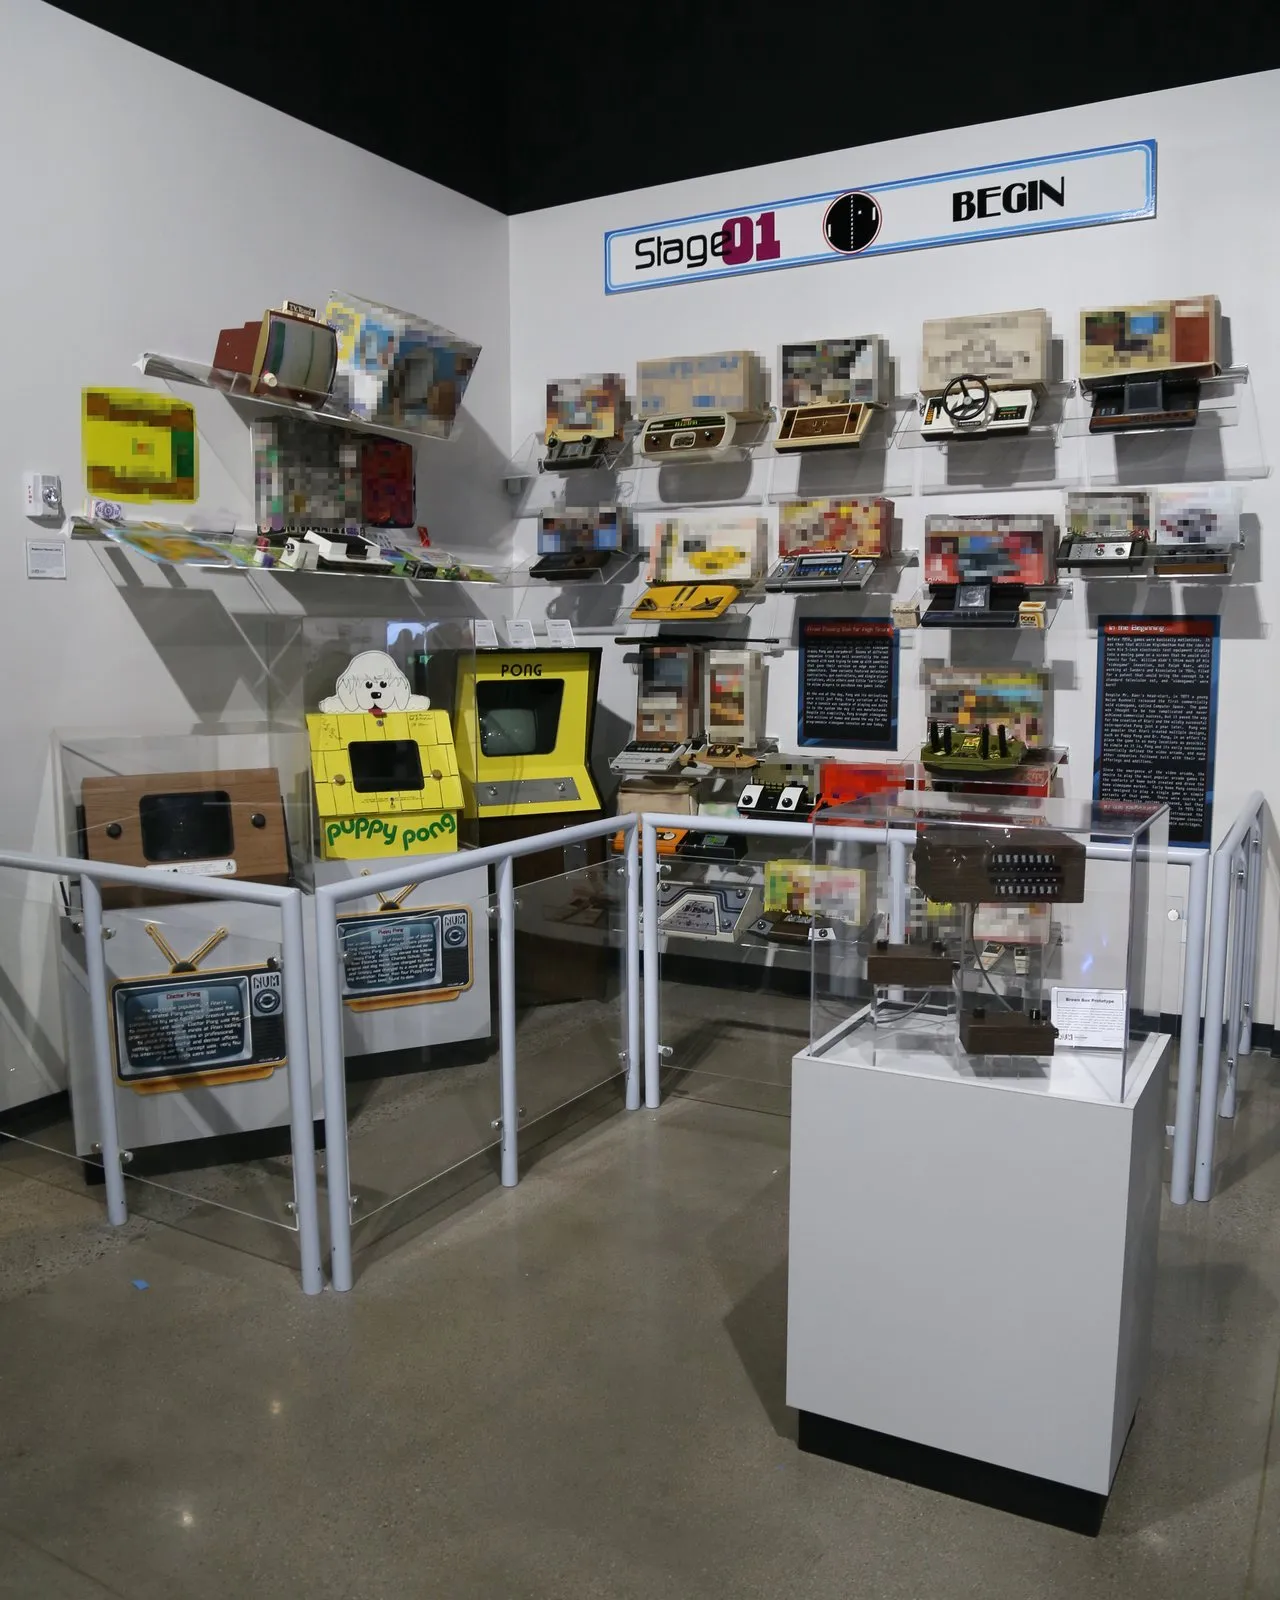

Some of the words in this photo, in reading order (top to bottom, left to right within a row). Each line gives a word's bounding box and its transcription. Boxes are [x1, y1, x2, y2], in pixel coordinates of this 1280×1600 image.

[952, 176, 1065, 223] BEGIN
[635, 230, 731, 270] Stage
[721, 211, 780, 266] 01
[500, 663, 542, 678] PONG
[327, 817, 398, 846] puppy
[402, 813, 456, 851] pong
[444, 914, 466, 926] NUM
[253, 975, 279, 989] NUM
